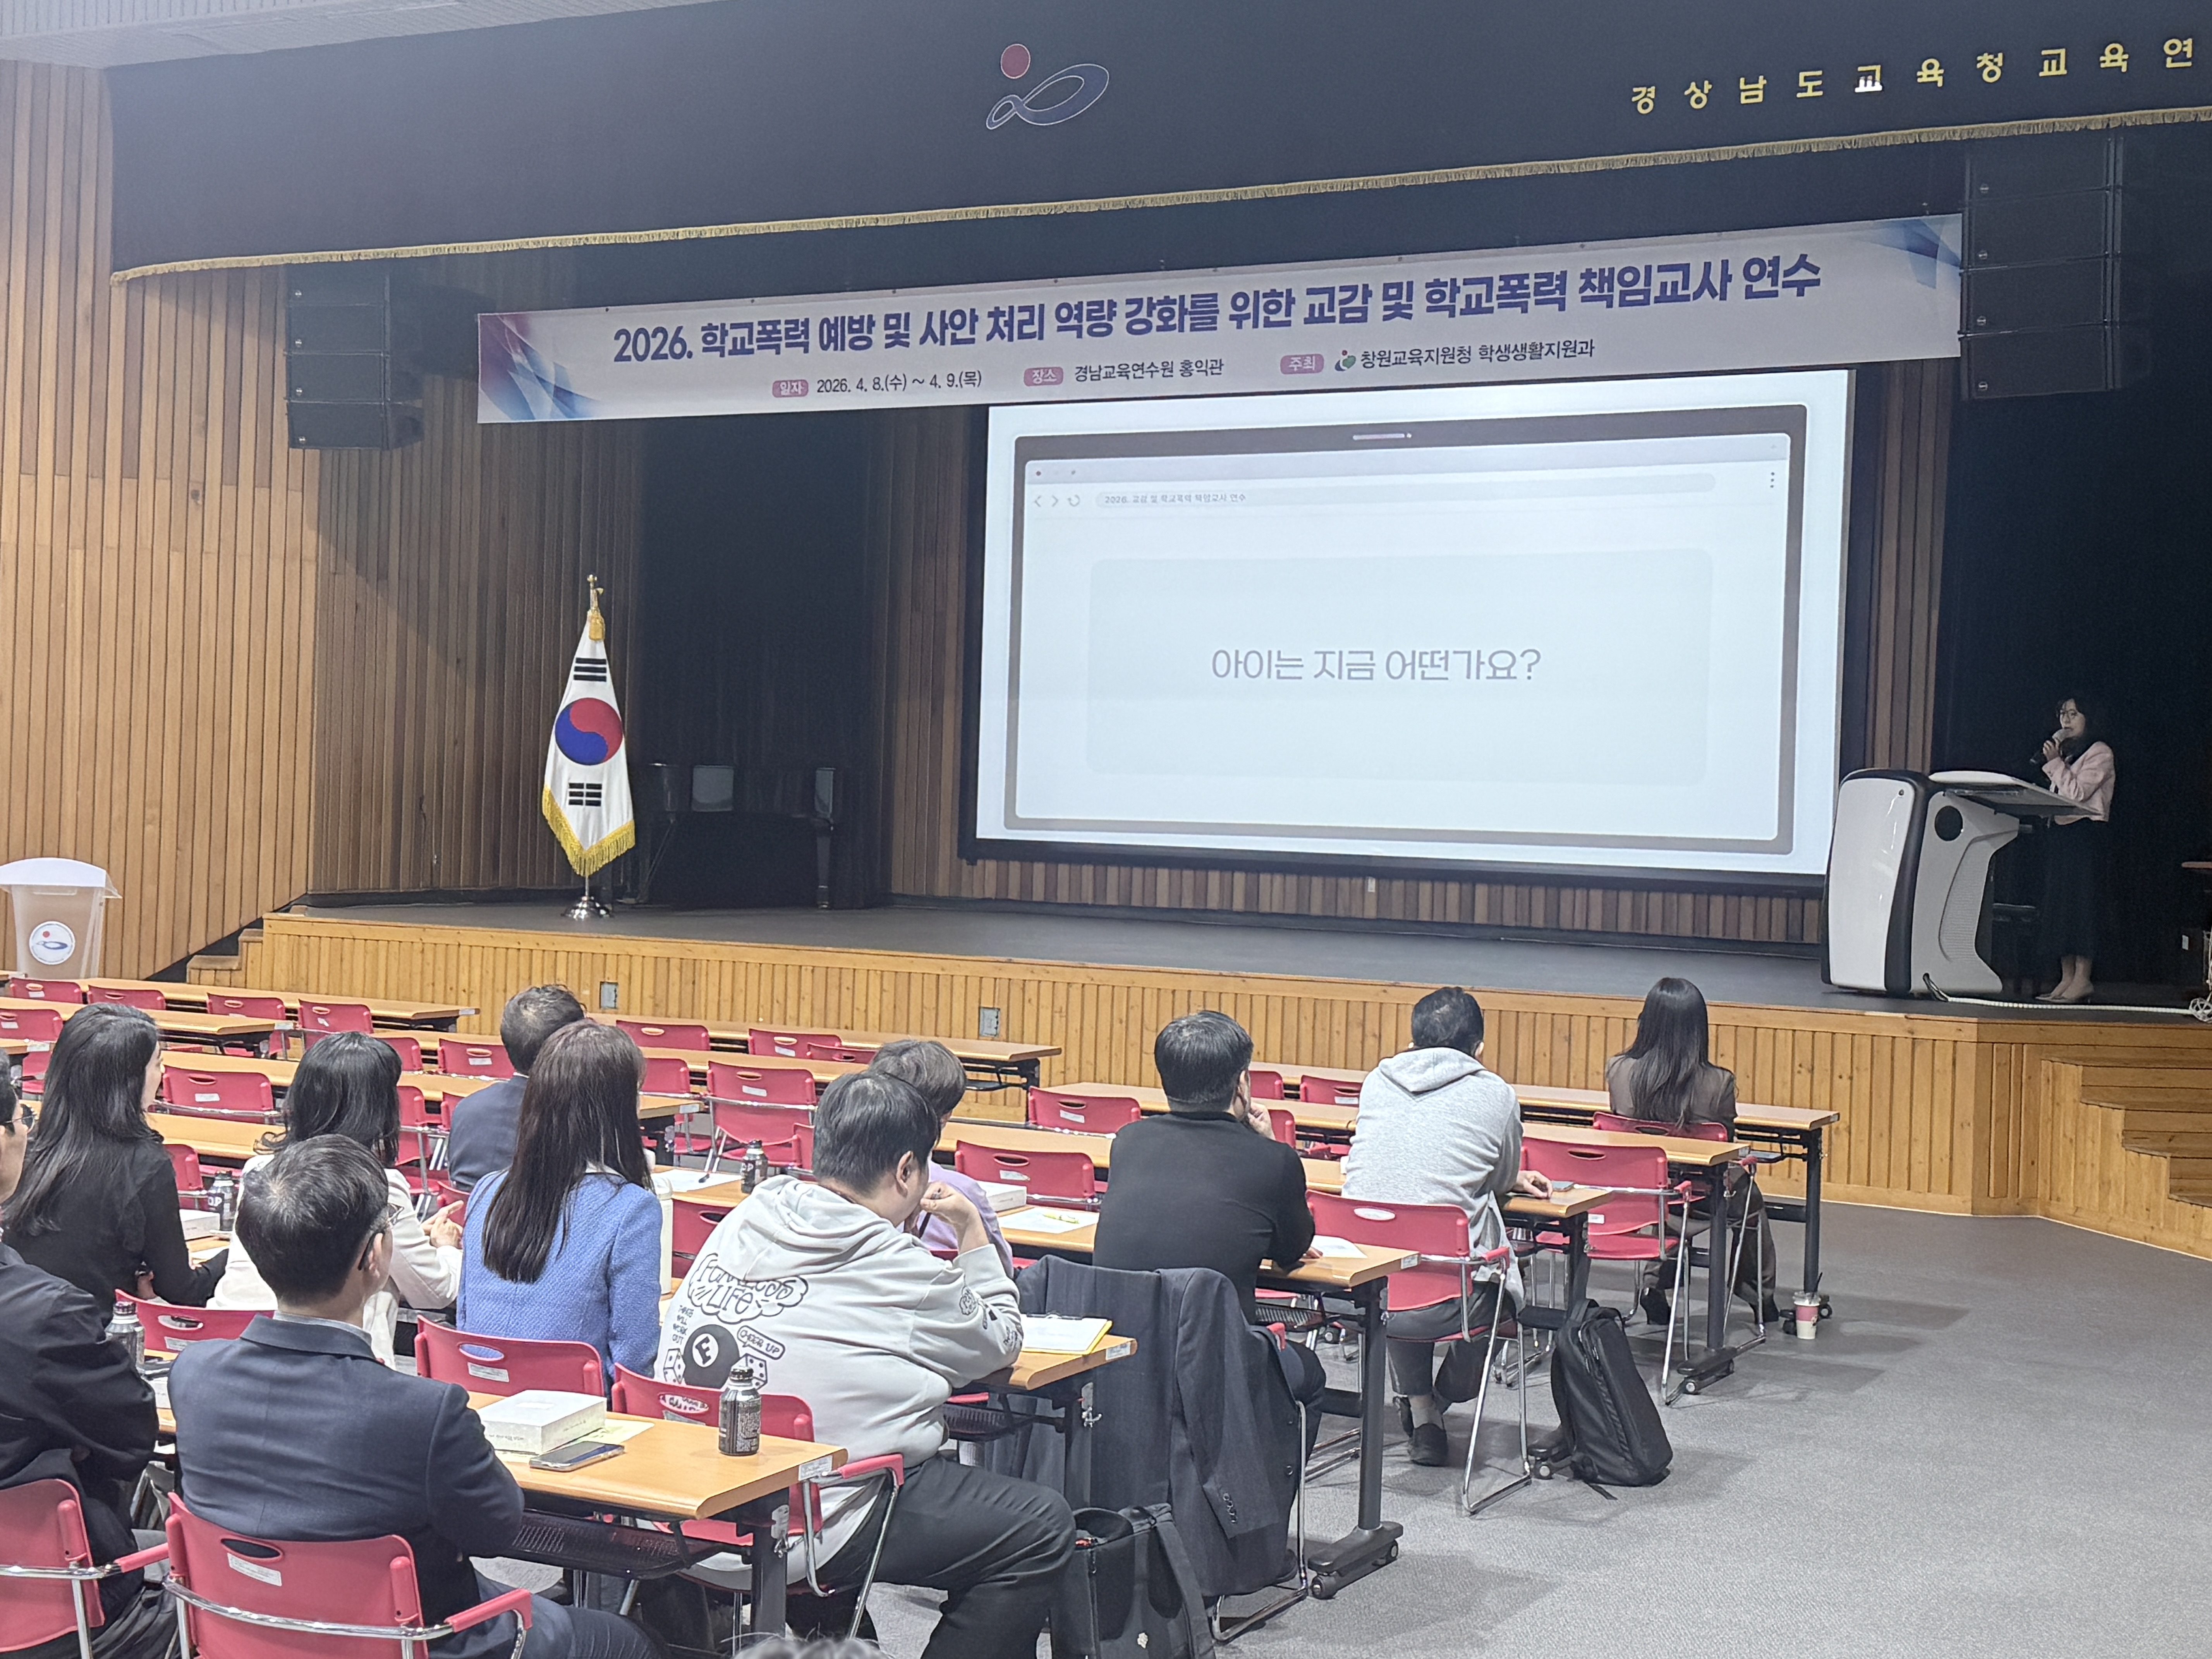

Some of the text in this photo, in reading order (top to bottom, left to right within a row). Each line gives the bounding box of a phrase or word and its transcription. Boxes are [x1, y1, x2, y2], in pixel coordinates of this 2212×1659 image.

[614, 254, 1820, 362] 2026. 학교폭력 예방 및 사안 처리 역량 강화를 위한 교감 및 학교폭력 책임교사 연수
[1288, 339, 1595, 371] 주최 창원교육지원청 학생생활지원과
[780, 381, 804, 396] 일자
[817, 378, 851, 393] 2026.
[856, 378, 867, 392] 4.
[872, 373, 907, 391] 8.(수)
[929, 374, 941, 388] 4.
[947, 370, 981, 388] 9.(목)
[1032, 359, 1224, 384] 장소 경남교육연수원 홍익관
[1212, 649, 1540, 680] 아이는 지금 어떤가요?
[695, 1336, 711, 1365] F
[765, 1343, 780, 1354] UP
